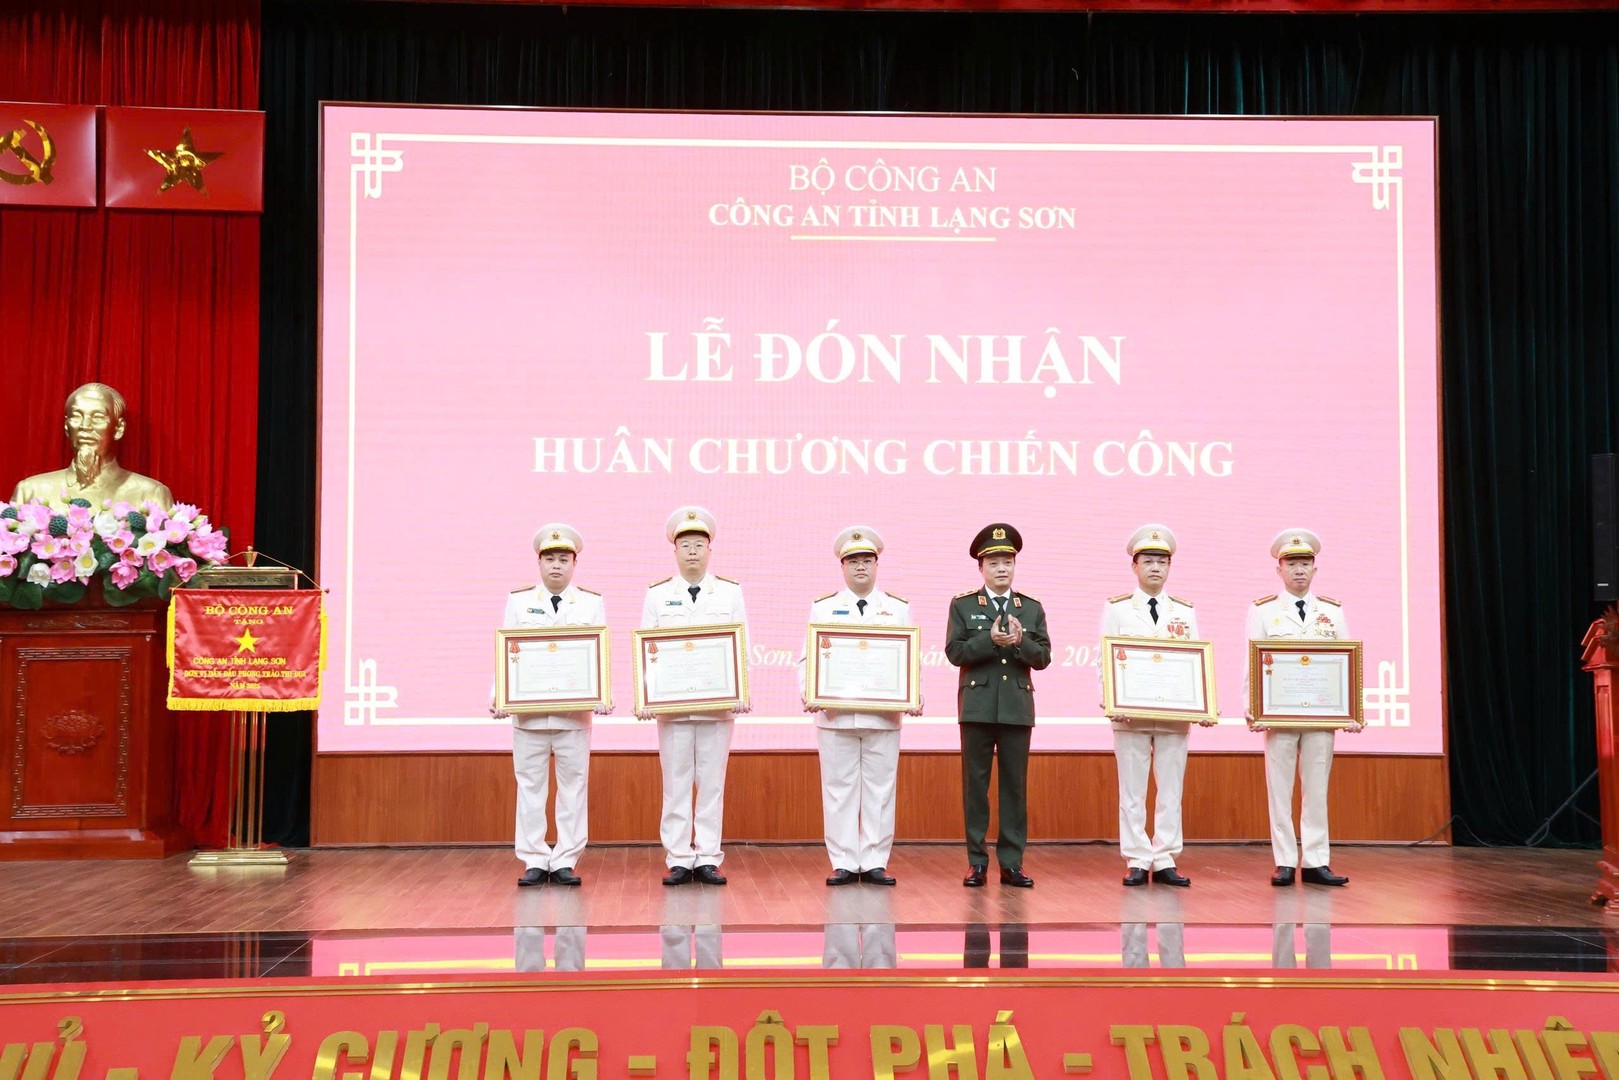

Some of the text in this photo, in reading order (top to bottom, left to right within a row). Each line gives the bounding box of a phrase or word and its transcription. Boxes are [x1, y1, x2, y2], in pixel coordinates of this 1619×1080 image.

[789, 157, 997, 196] BỘ CÔNG AN
[708, 196, 1077, 234] CÔNG AN TỈNH LẠNG SƠN
[644, 316, 1126, 399] LỄ ĐÓN NHẬN
[532, 425, 1235, 477] HUÂN CHƯƠNG CHIẾN CÔNG
[204, 603, 294, 617] BỘ CÔNG AN
[193, 655, 215, 665] CÔNG
[217, 657, 228, 665] AN
[870, 1010, 1035, 1080] PHÁ
[1109, 1011, 1387, 1080] TRÁCH
